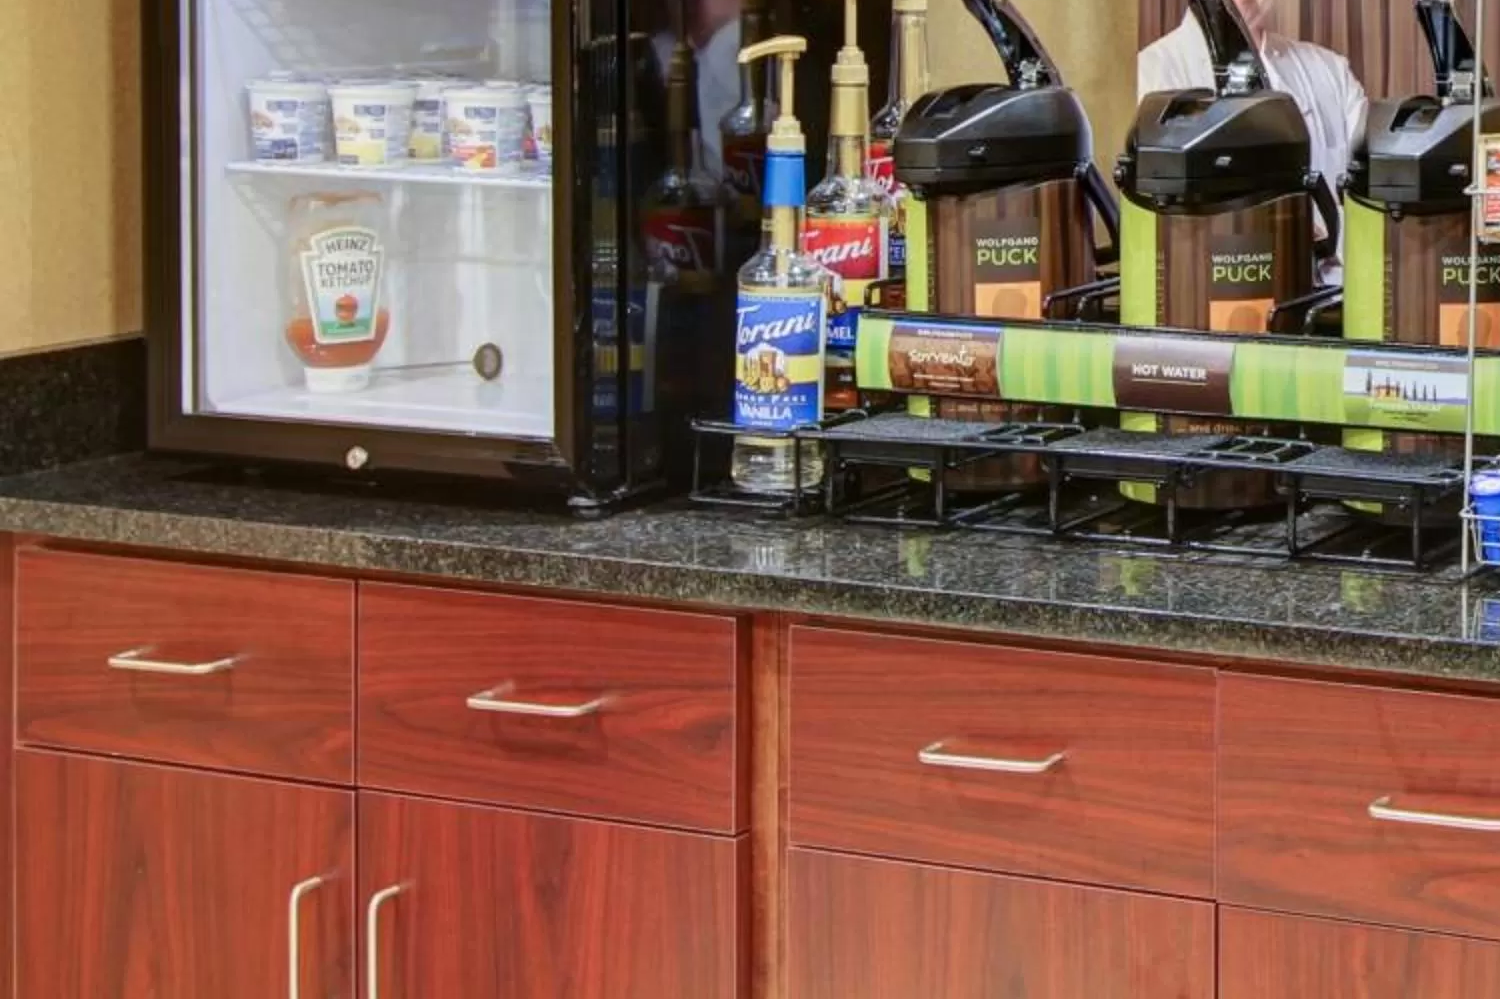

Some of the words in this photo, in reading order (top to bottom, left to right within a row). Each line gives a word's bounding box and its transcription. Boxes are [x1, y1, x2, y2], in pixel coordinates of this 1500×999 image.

[326, 238, 368, 253] HEINZ
[975, 236, 1039, 248] WOLFGANG
[977, 248, 1038, 266] PUCK
[1212, 252, 1273, 264] WOLFGANG
[318, 259, 373, 276] TOMATO
[1213, 265, 1272, 282] PUCK
[736, 303, 816, 347] Torani
[1132, 363, 1159, 377] HOT
[1162, 364, 1207, 380] WATER
[739, 402, 793, 419] VANILLA
